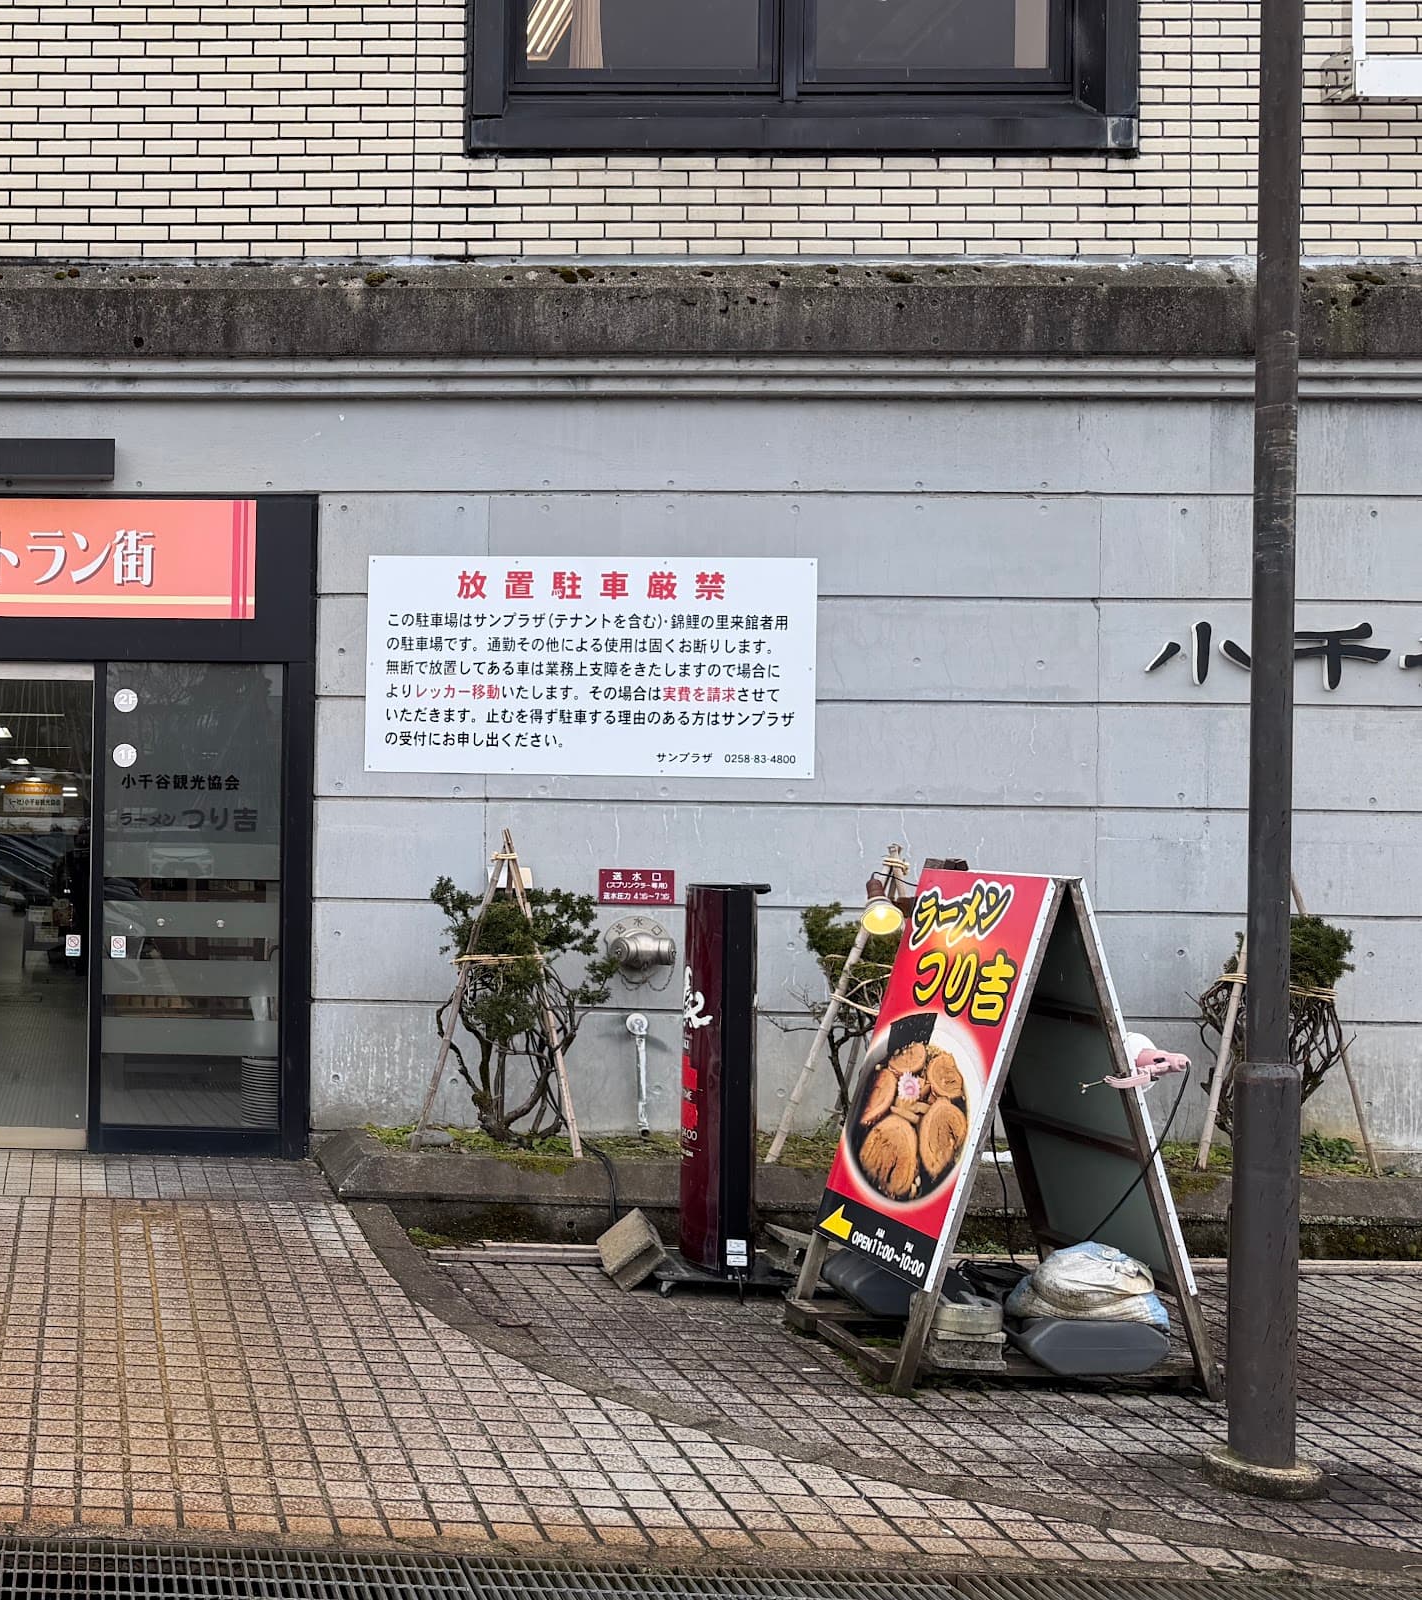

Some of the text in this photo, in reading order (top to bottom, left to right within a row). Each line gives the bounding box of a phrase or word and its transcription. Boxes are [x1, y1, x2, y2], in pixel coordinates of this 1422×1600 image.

[457, 569, 726, 601] 放置駐車厳禁
[1144, 620, 1422, 691] 小千
[386, 660, 780, 679] 無断で放置してある車は業務上支障をきたしますので場合に
[385, 731, 564, 749] の受付にお申し出ください。
[656, 752, 796, 765] サンプラザ 0258-83-4800
[121, 774, 240, 791] 小千谷観光協会
[119, 807, 259, 833] ラーメン つり吉
[612, 871, 662, 882] 送水口
[910, 880, 1014, 949] ラーメン
[914, 948, 1018, 1026] つり吉
